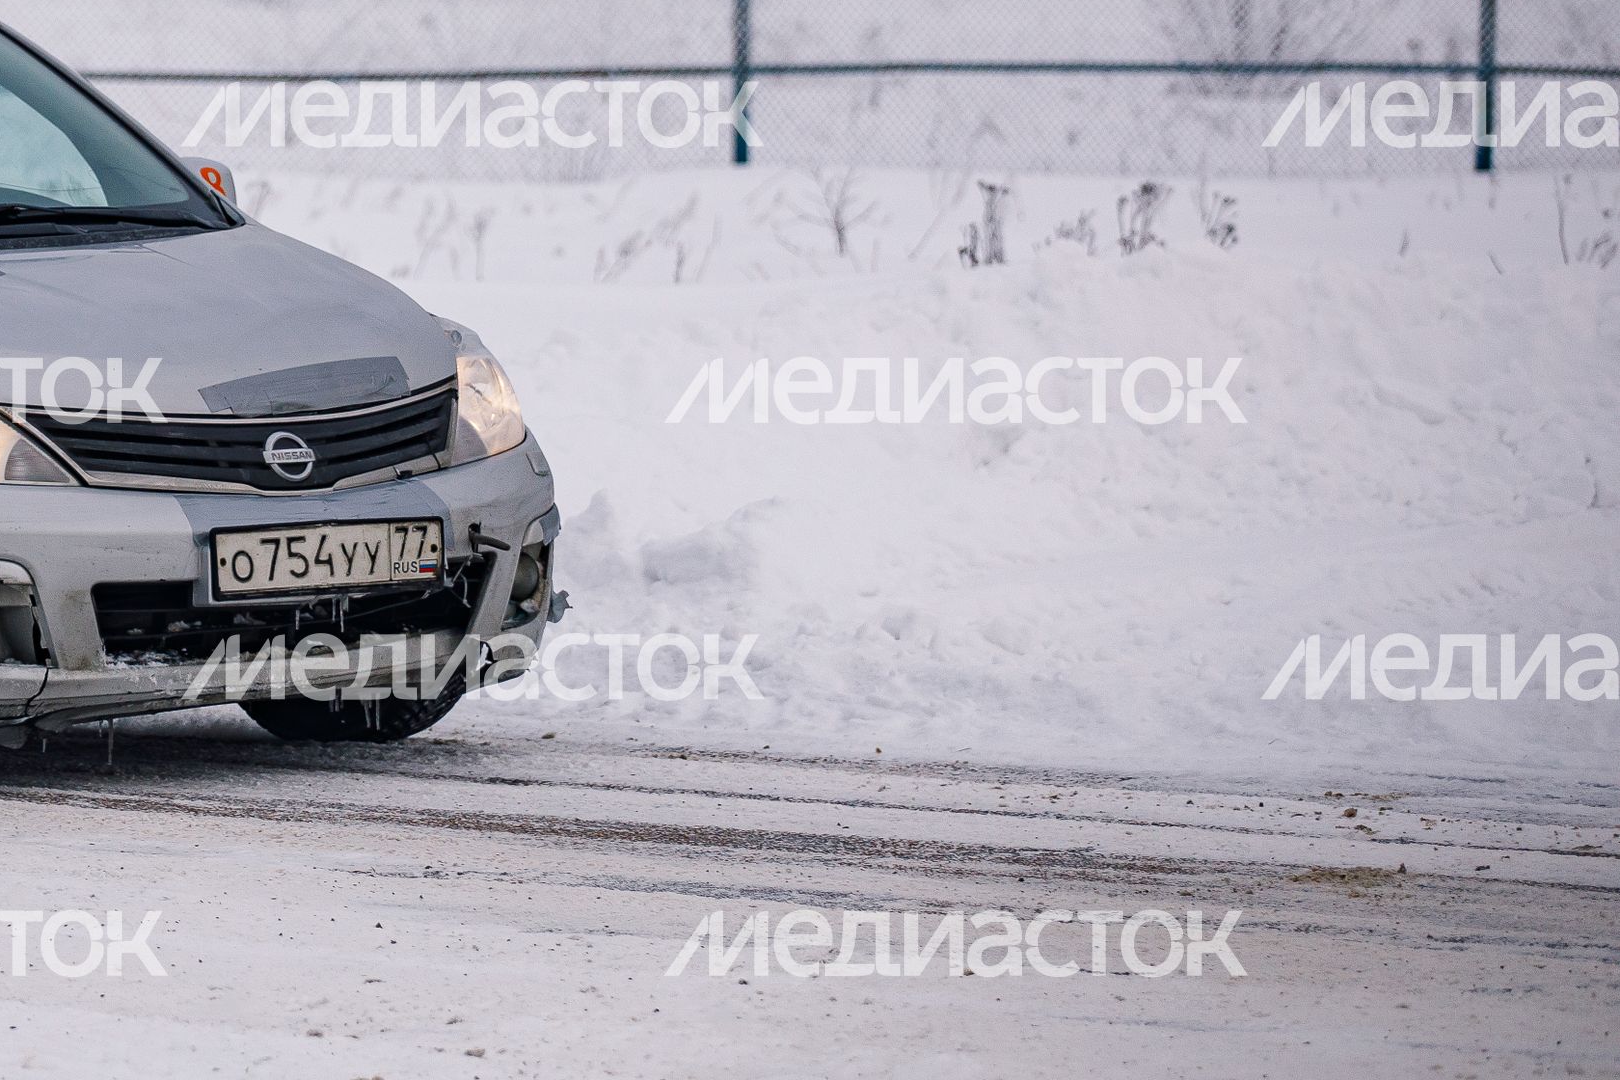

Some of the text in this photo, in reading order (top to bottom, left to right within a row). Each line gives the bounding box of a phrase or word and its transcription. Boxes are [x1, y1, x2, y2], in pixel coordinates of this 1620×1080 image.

[271, 451, 312, 461] NISSAN
[394, 525, 428, 561] 77
[393, 561, 418, 574] RUS
